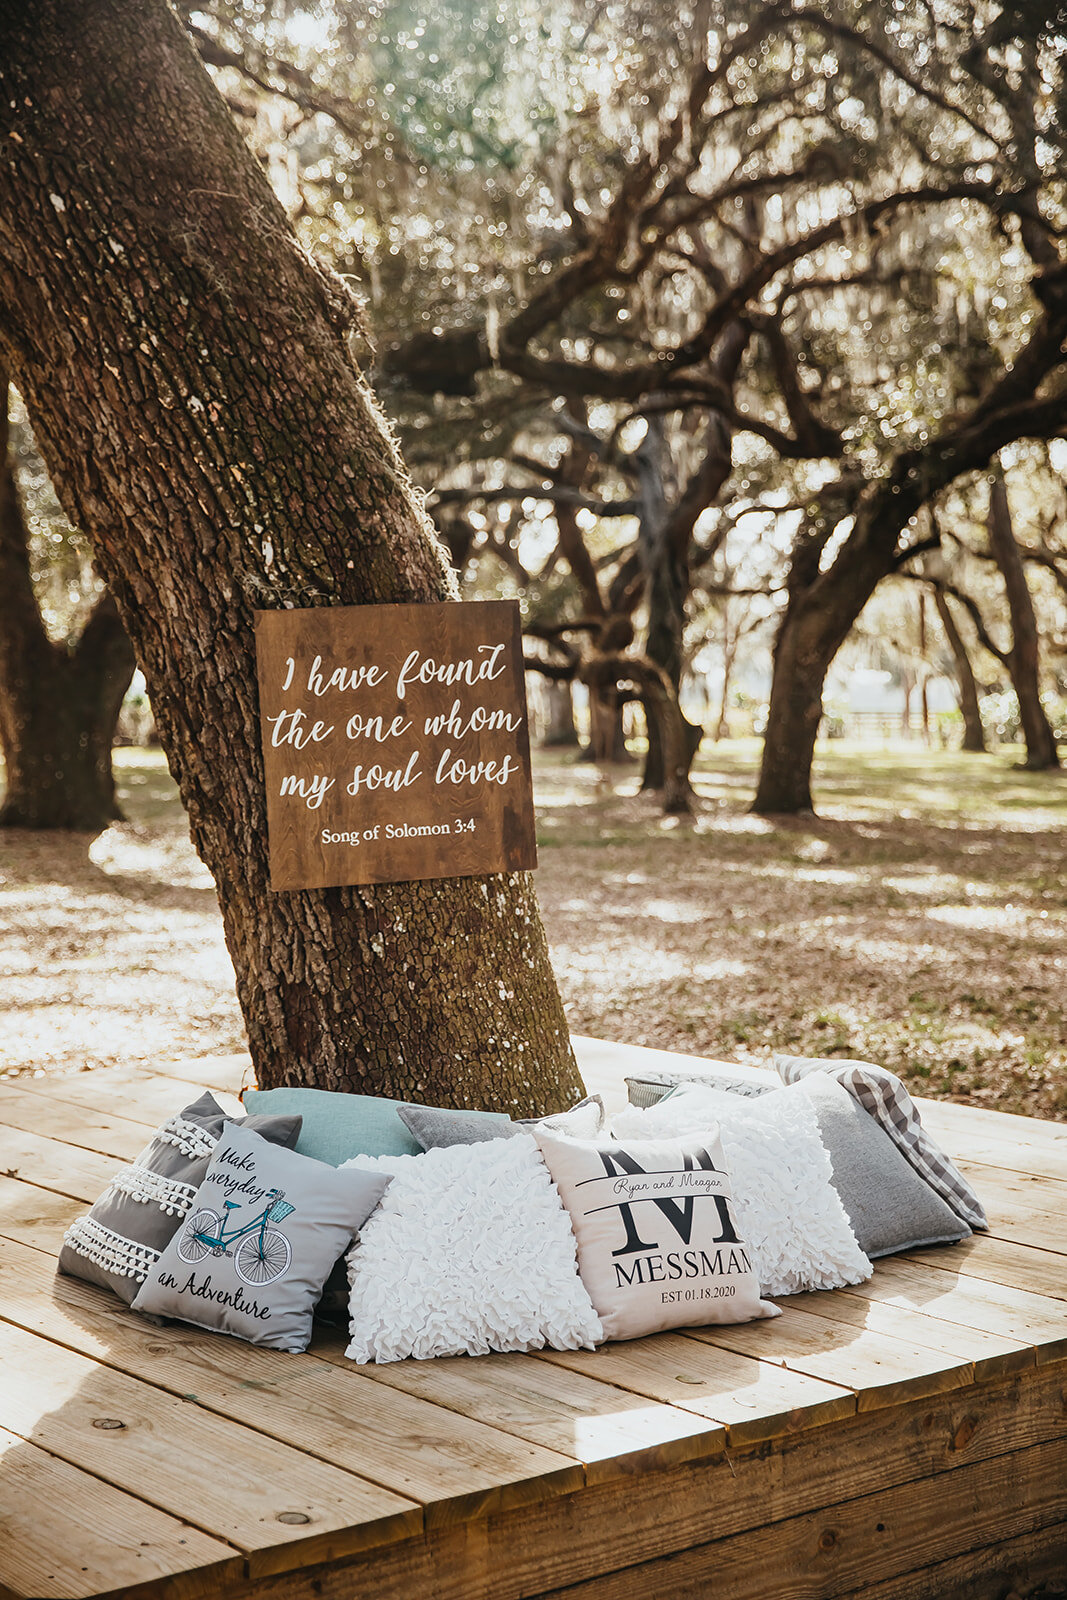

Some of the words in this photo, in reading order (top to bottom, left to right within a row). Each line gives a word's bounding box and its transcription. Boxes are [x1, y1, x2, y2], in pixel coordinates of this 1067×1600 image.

[282, 657, 295, 691] I
[308, 655, 388, 697] have
[396, 643, 506, 700] found
[266, 708, 334, 750] the
[346, 714, 413, 743] one
[424, 699, 522, 740] whom
[279, 774, 335, 810] my
[346, 750, 422, 796] soul
[435, 748, 519, 785] loves
[321, 829, 360, 846] Song
[362, 825, 381, 841] of
[385, 822, 451, 840] Solomon
[454, 818, 476, 834] 3:4
[216, 1147, 256, 1172] Make
[206, 1172, 267, 1205] everyday
[613, 1178, 650, 1198] Ryan
[653, 1176, 675, 1190] and
[158, 1271, 179, 1290] an
[178, 1272, 272, 1320] Adventure
[661, 1290, 683, 1304] EST
[685, 1286, 736, 1301] 01.18.2020
